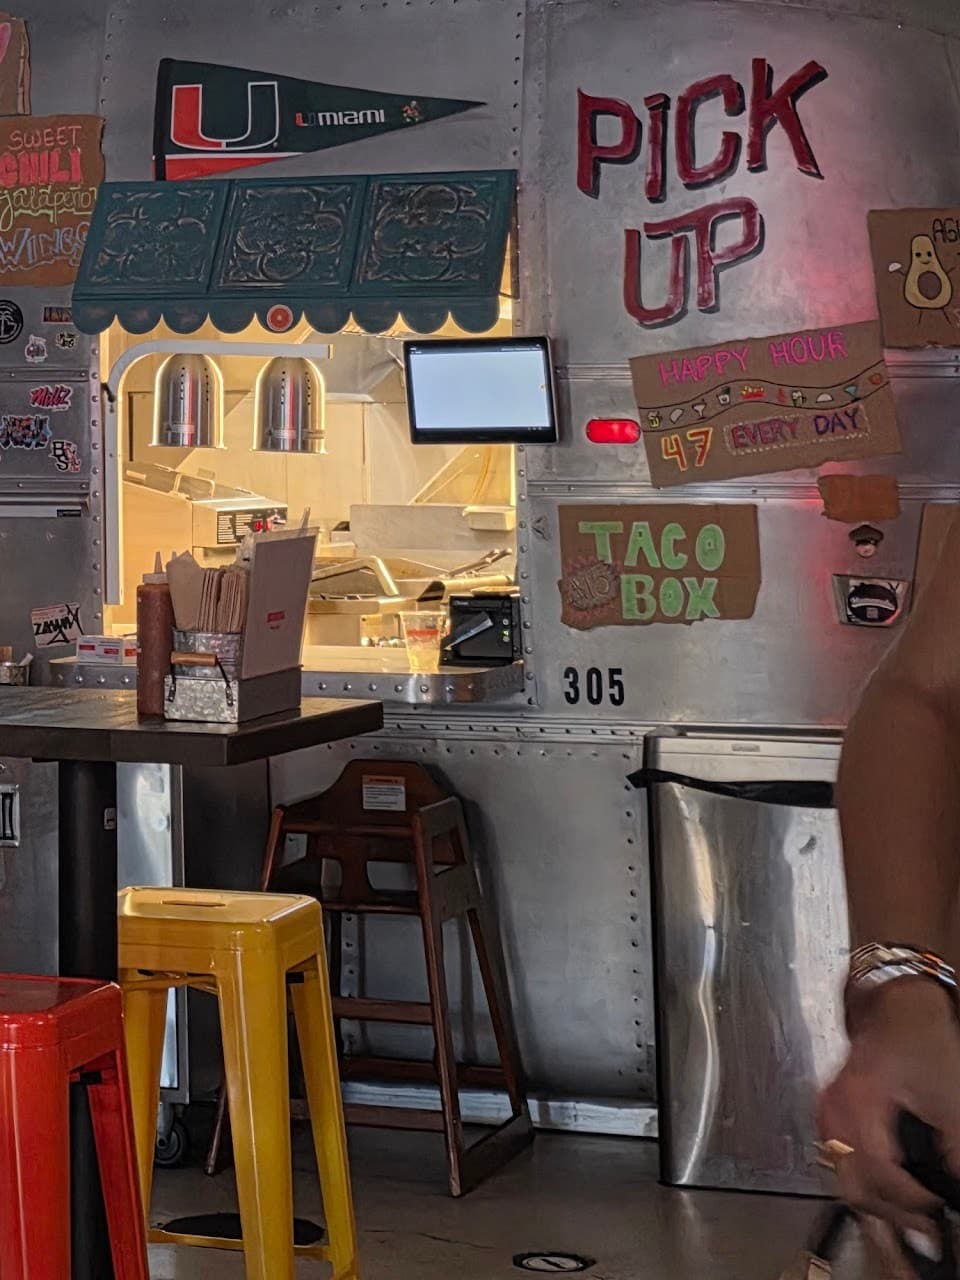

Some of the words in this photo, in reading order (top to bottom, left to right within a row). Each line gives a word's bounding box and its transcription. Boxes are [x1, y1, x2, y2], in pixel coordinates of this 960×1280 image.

[7, 125, 82, 151] SWEET
[170, 81, 279, 151] U
[577, 58, 828, 203] PICK
[623, 195, 766, 330] UP
[657, 346, 750, 387] HAPPY
[768, 330, 849, 368] HOUR
[732, 419, 799, 449] EVERY
[813, 408, 860, 436] DAY
[578, 521, 726, 571] TACO
[621, 574, 720, 620] BOX
[564, 666, 625, 707] 305
